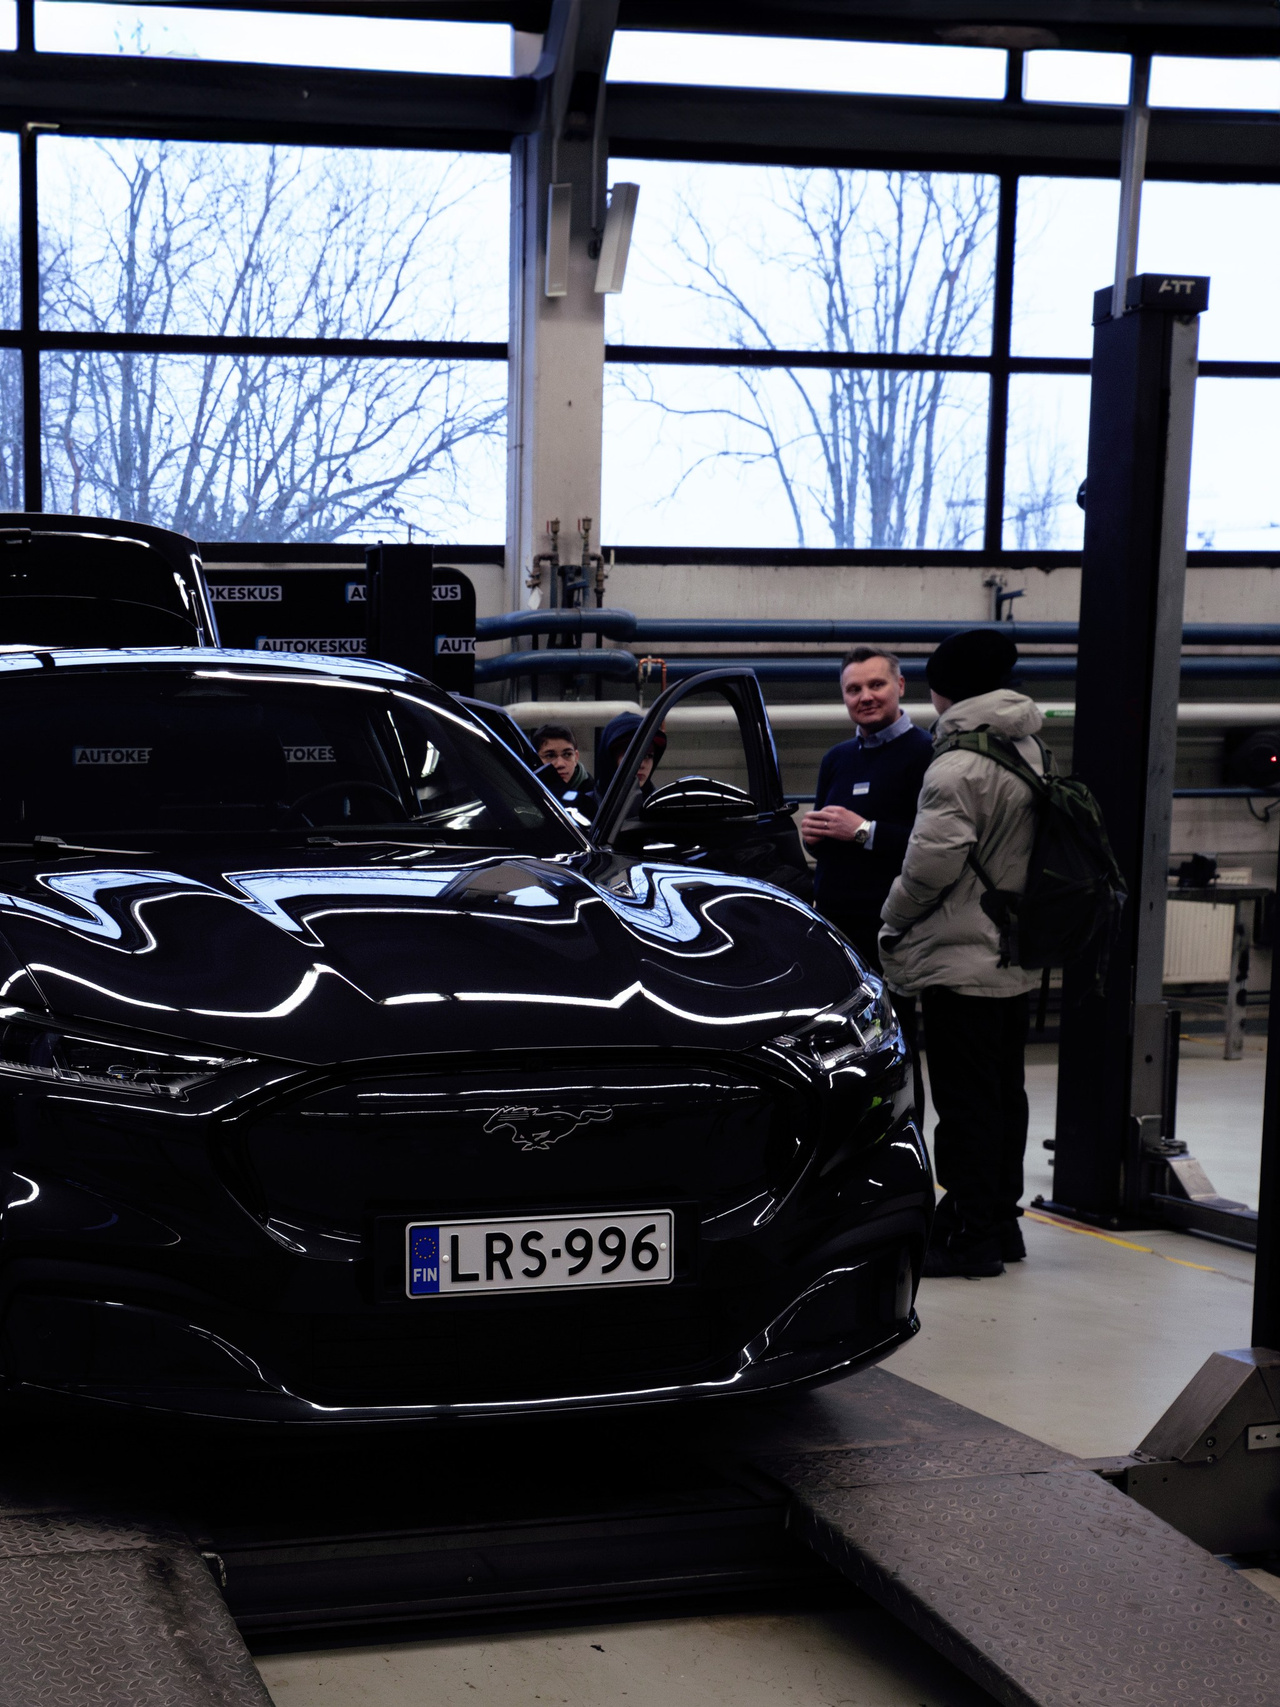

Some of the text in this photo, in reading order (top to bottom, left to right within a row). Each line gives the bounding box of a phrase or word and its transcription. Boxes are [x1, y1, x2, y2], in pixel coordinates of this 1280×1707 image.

[1158, 280, 1196, 294] ATT
[440, 639, 476, 652] AUT
[450, 1223, 660, 1283] LRS-996
[413, 1267, 438, 1283] FIN
